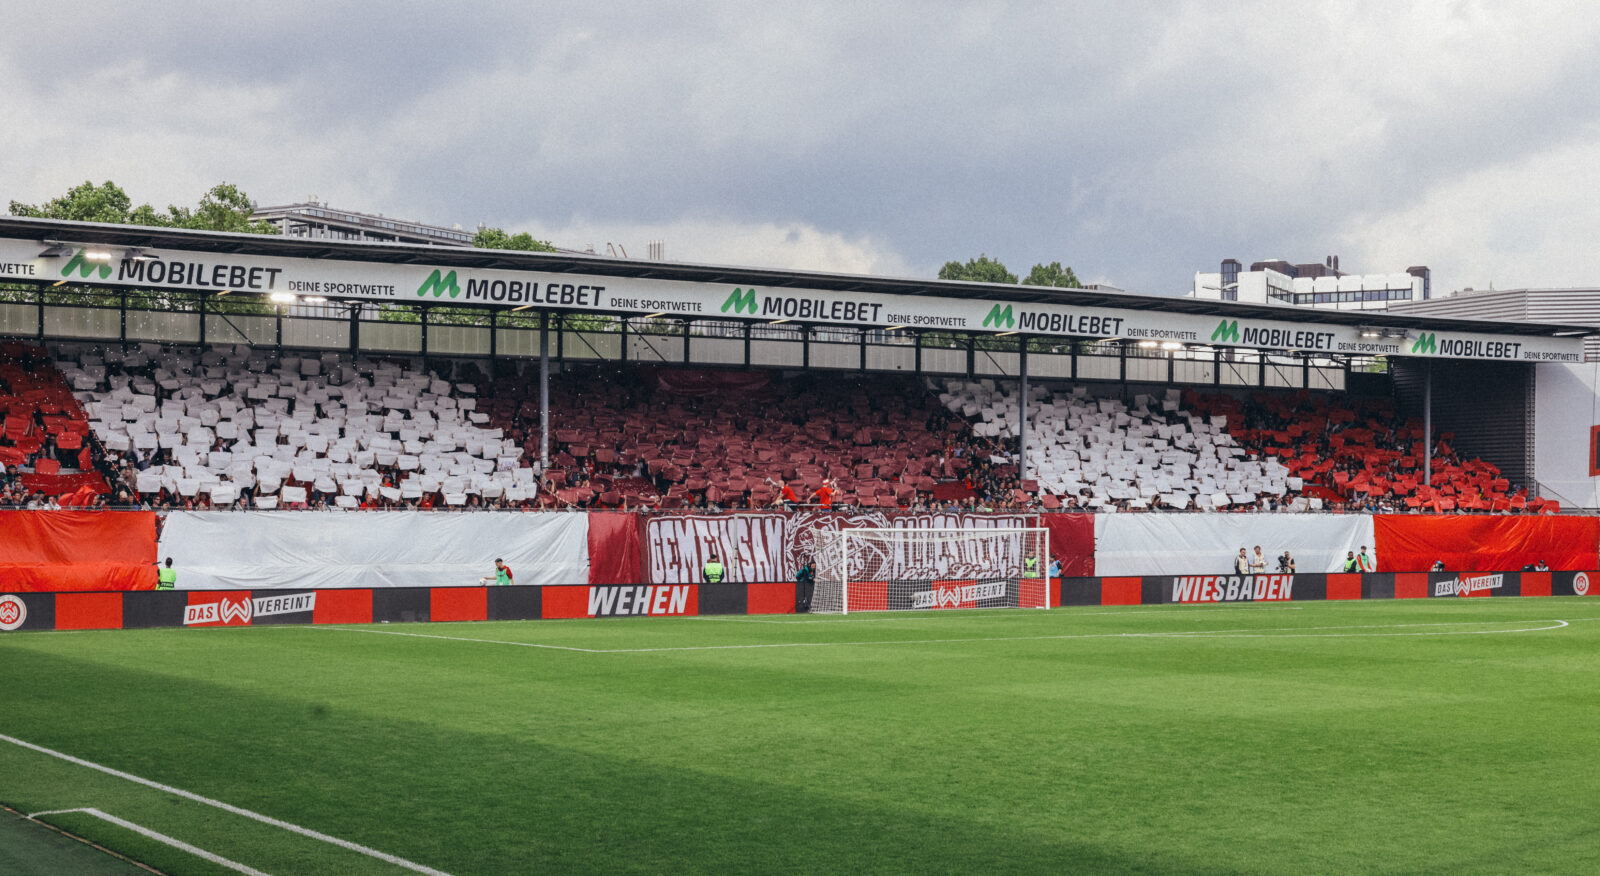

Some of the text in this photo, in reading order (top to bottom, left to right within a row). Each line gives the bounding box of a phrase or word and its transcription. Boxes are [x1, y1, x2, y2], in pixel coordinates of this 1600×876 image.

[118, 258, 282, 290] MOBILEBET
[288, 280, 395, 296] DEINE SPORTWETTE
[466, 278, 605, 307] MOBILEBET
[610, 297, 702, 312] DEINE SPORTWETTE
[762, 296, 883, 322] MOBILEBET
[887, 314, 966, 326] DEINE SPORTWETTE
[1018, 312, 1124, 335] MOBILEBET
[1127, 328, 1197, 340] DEINE SPORTWETTE
[1242, 327, 1335, 350] MOBILEBET
[1338, 342, 1399, 353] DEINE SPORTWETTE
[1440, 339, 1521, 359] MOBILEBET
[1524, 351, 1579, 362] DEINE SPORTWETTE
[964, 584, 1003, 599] VEREINT
[1172, 575, 1294, 602] WIESBADEN
[1437, 583, 1451, 594] DAS
[1473, 576, 1501, 589] VEREINT
[188, 606, 214, 621] DAS
[258, 595, 312, 614] VEREINT
[587, 586, 689, 616] WEHEN
